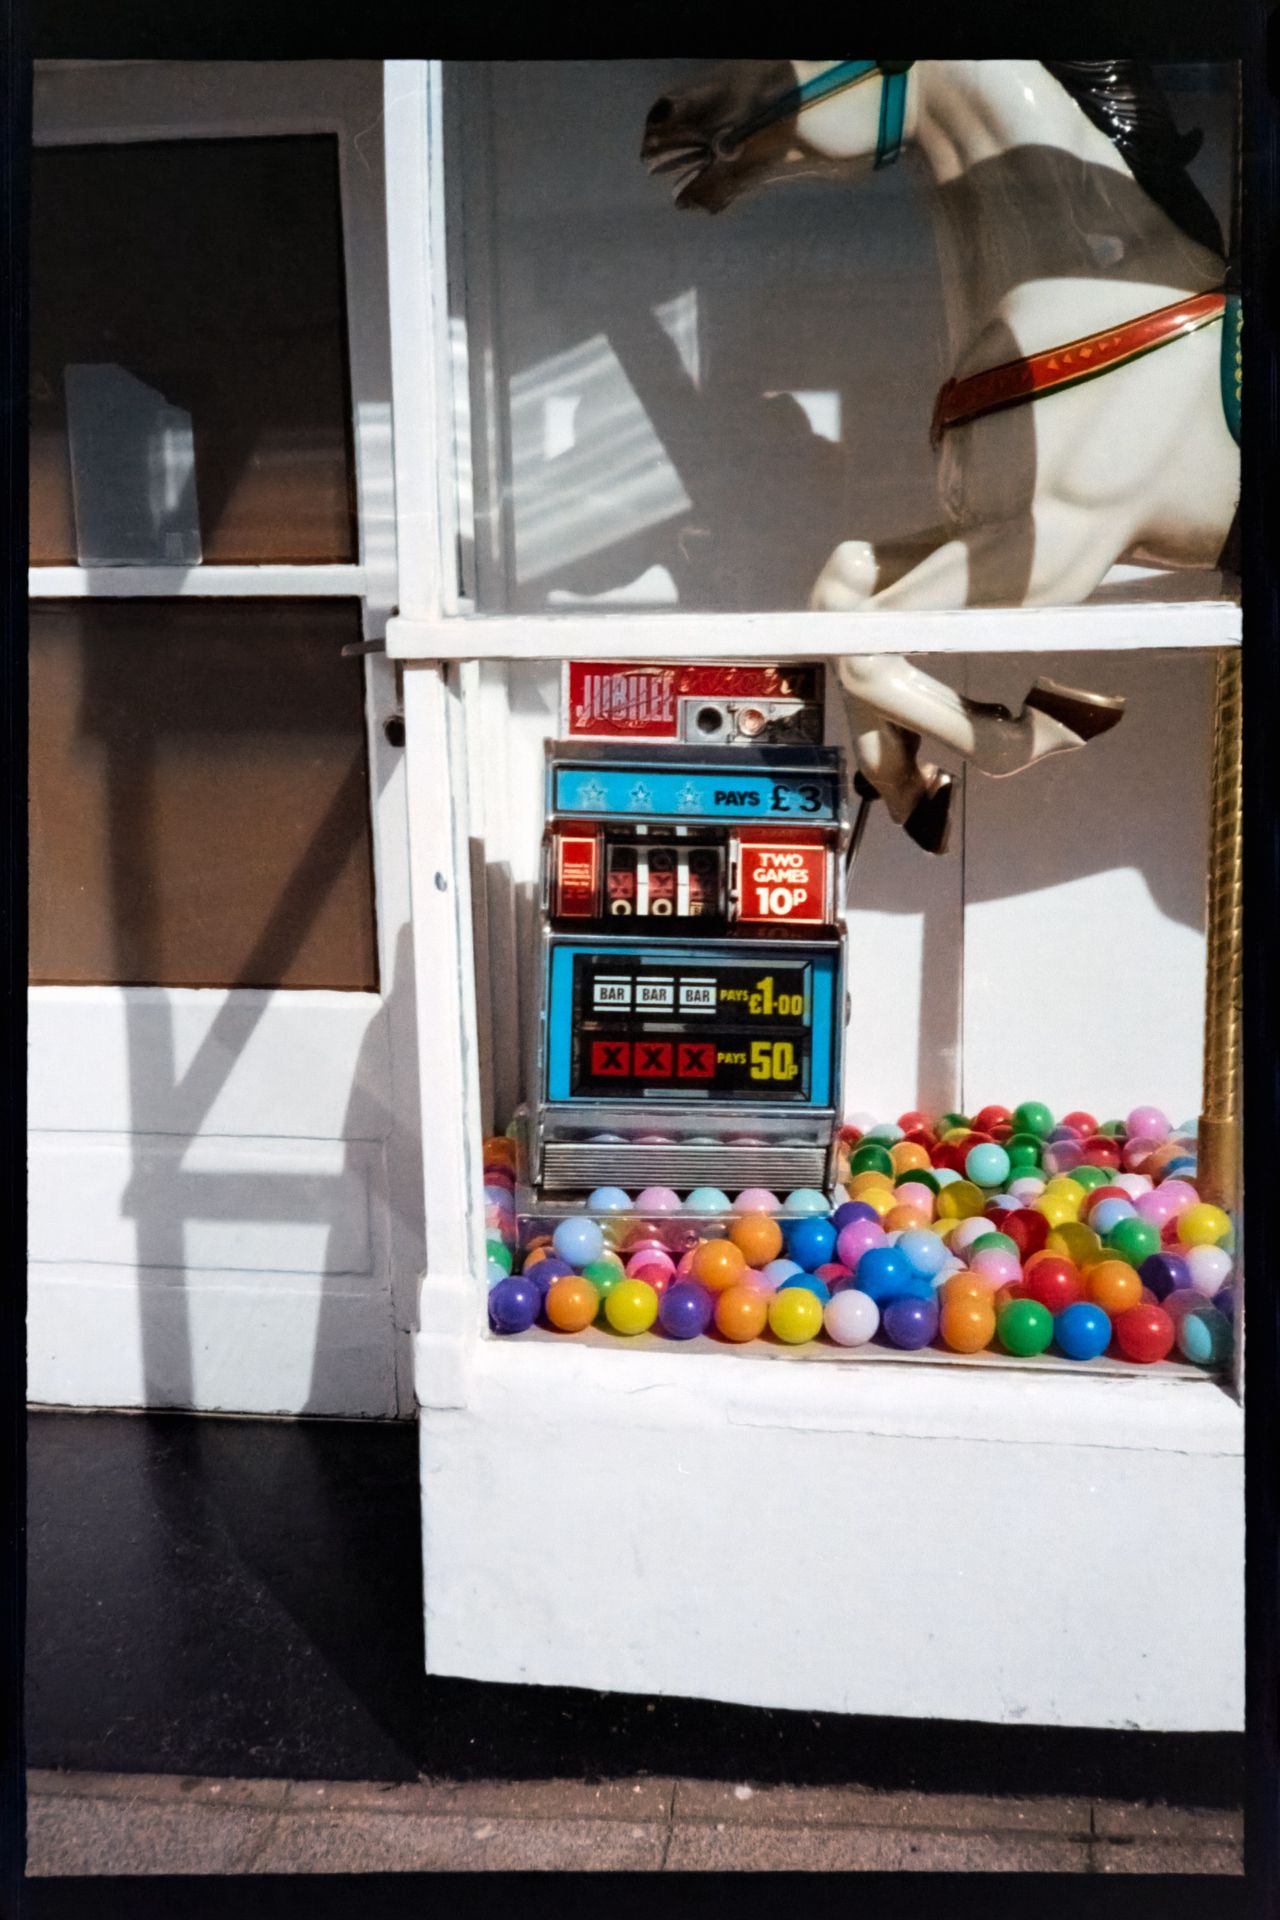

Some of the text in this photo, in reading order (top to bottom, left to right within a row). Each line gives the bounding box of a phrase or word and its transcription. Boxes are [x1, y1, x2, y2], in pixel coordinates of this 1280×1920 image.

[575, 674, 674, 722] JUBILEE
[714, 790, 760, 806] PAYS
[758, 852, 804, 868] TWO
[753, 868, 809, 883] GAMES
[600, 987, 625, 1001] BAR
[642, 988, 667, 1001] BAR
[685, 989, 710, 1002] BAR
[720, 989, 748, 1001] PAYS
[601, 1047, 624, 1070] X
[641, 1047, 665, 1071] X
[683, 1048, 708, 1072] X
[717, 1052, 746, 1065] PAYS
